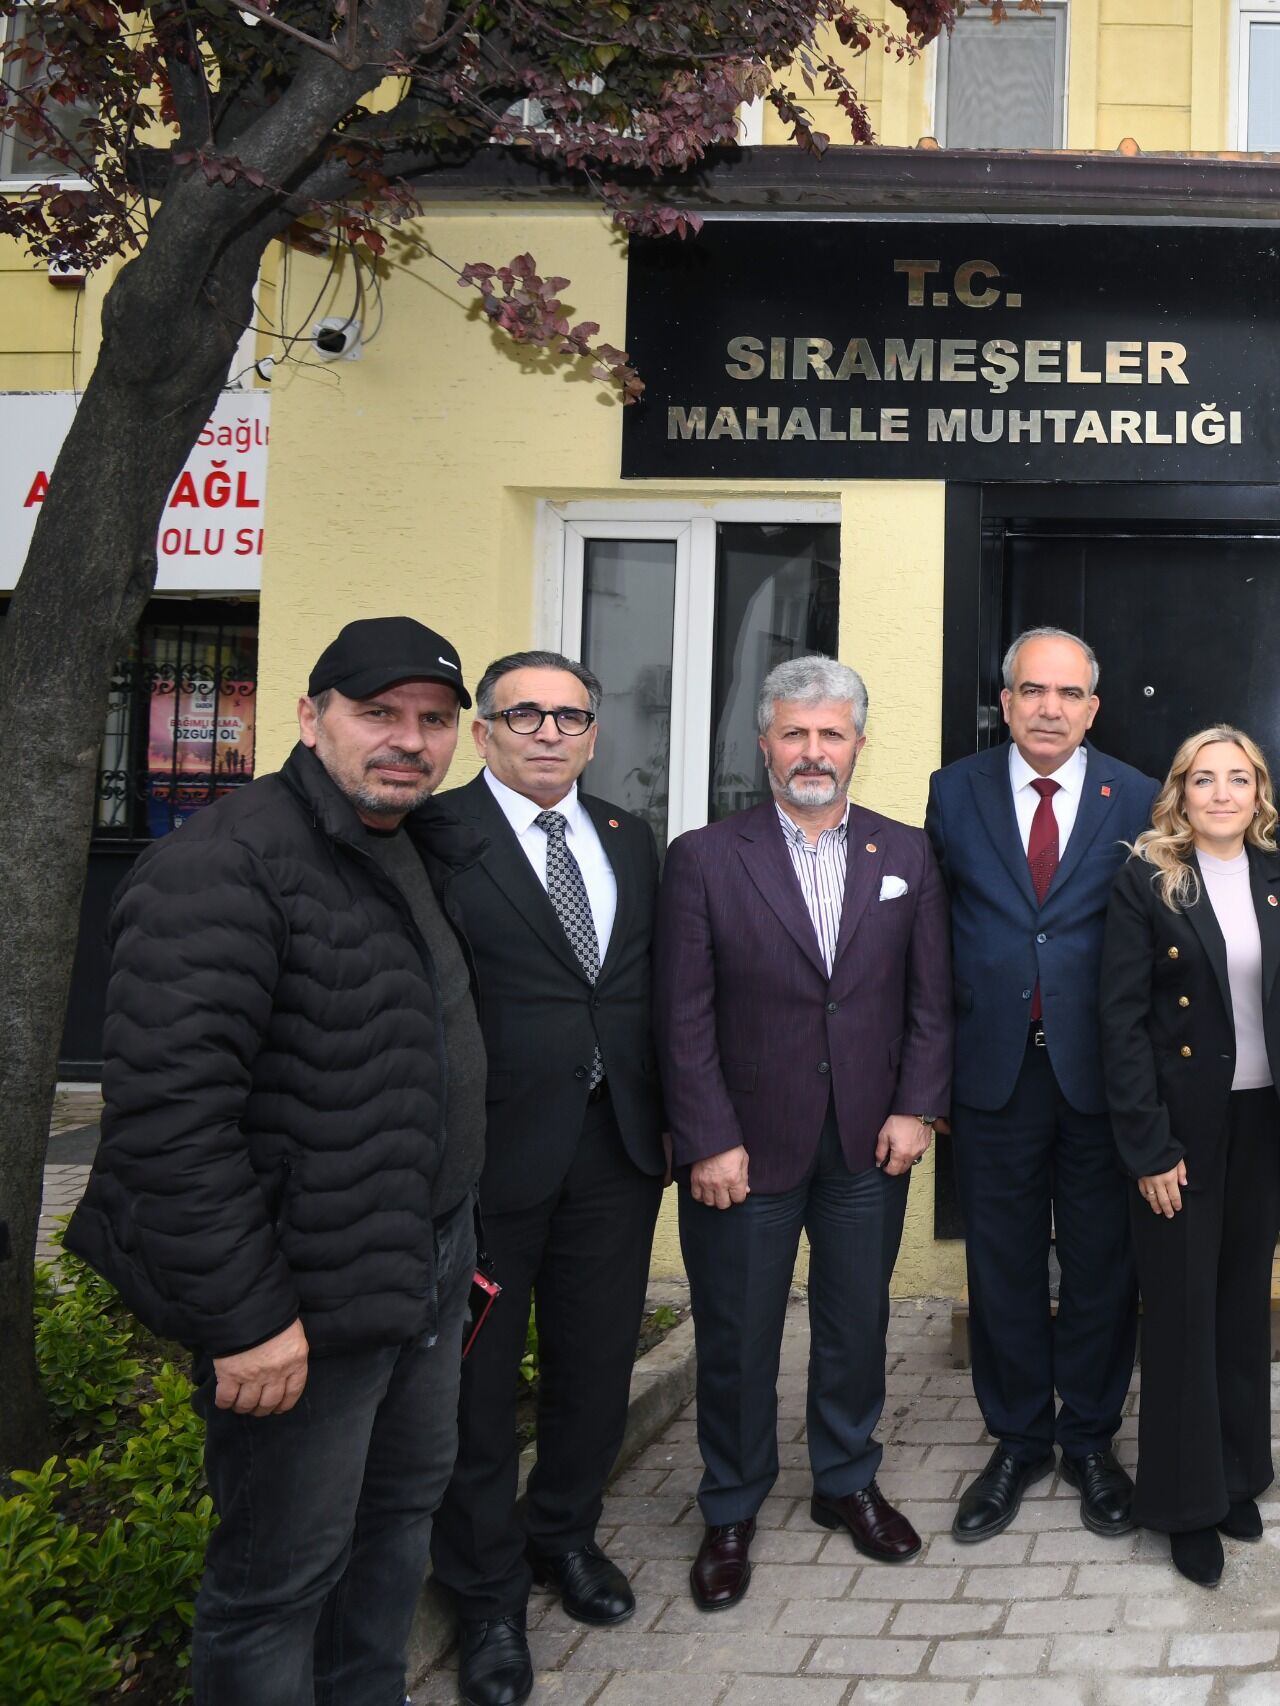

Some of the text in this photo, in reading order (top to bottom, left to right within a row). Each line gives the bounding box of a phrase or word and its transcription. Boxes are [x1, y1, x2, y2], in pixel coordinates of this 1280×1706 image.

[894, 259, 1022, 307] T.C.
[725, 336, 1190, 394] SIRAMEŞELER
[667, 402, 1242, 445] MAHALLE MUHTARLIĞI
[220, 729, 237, 740] OL
